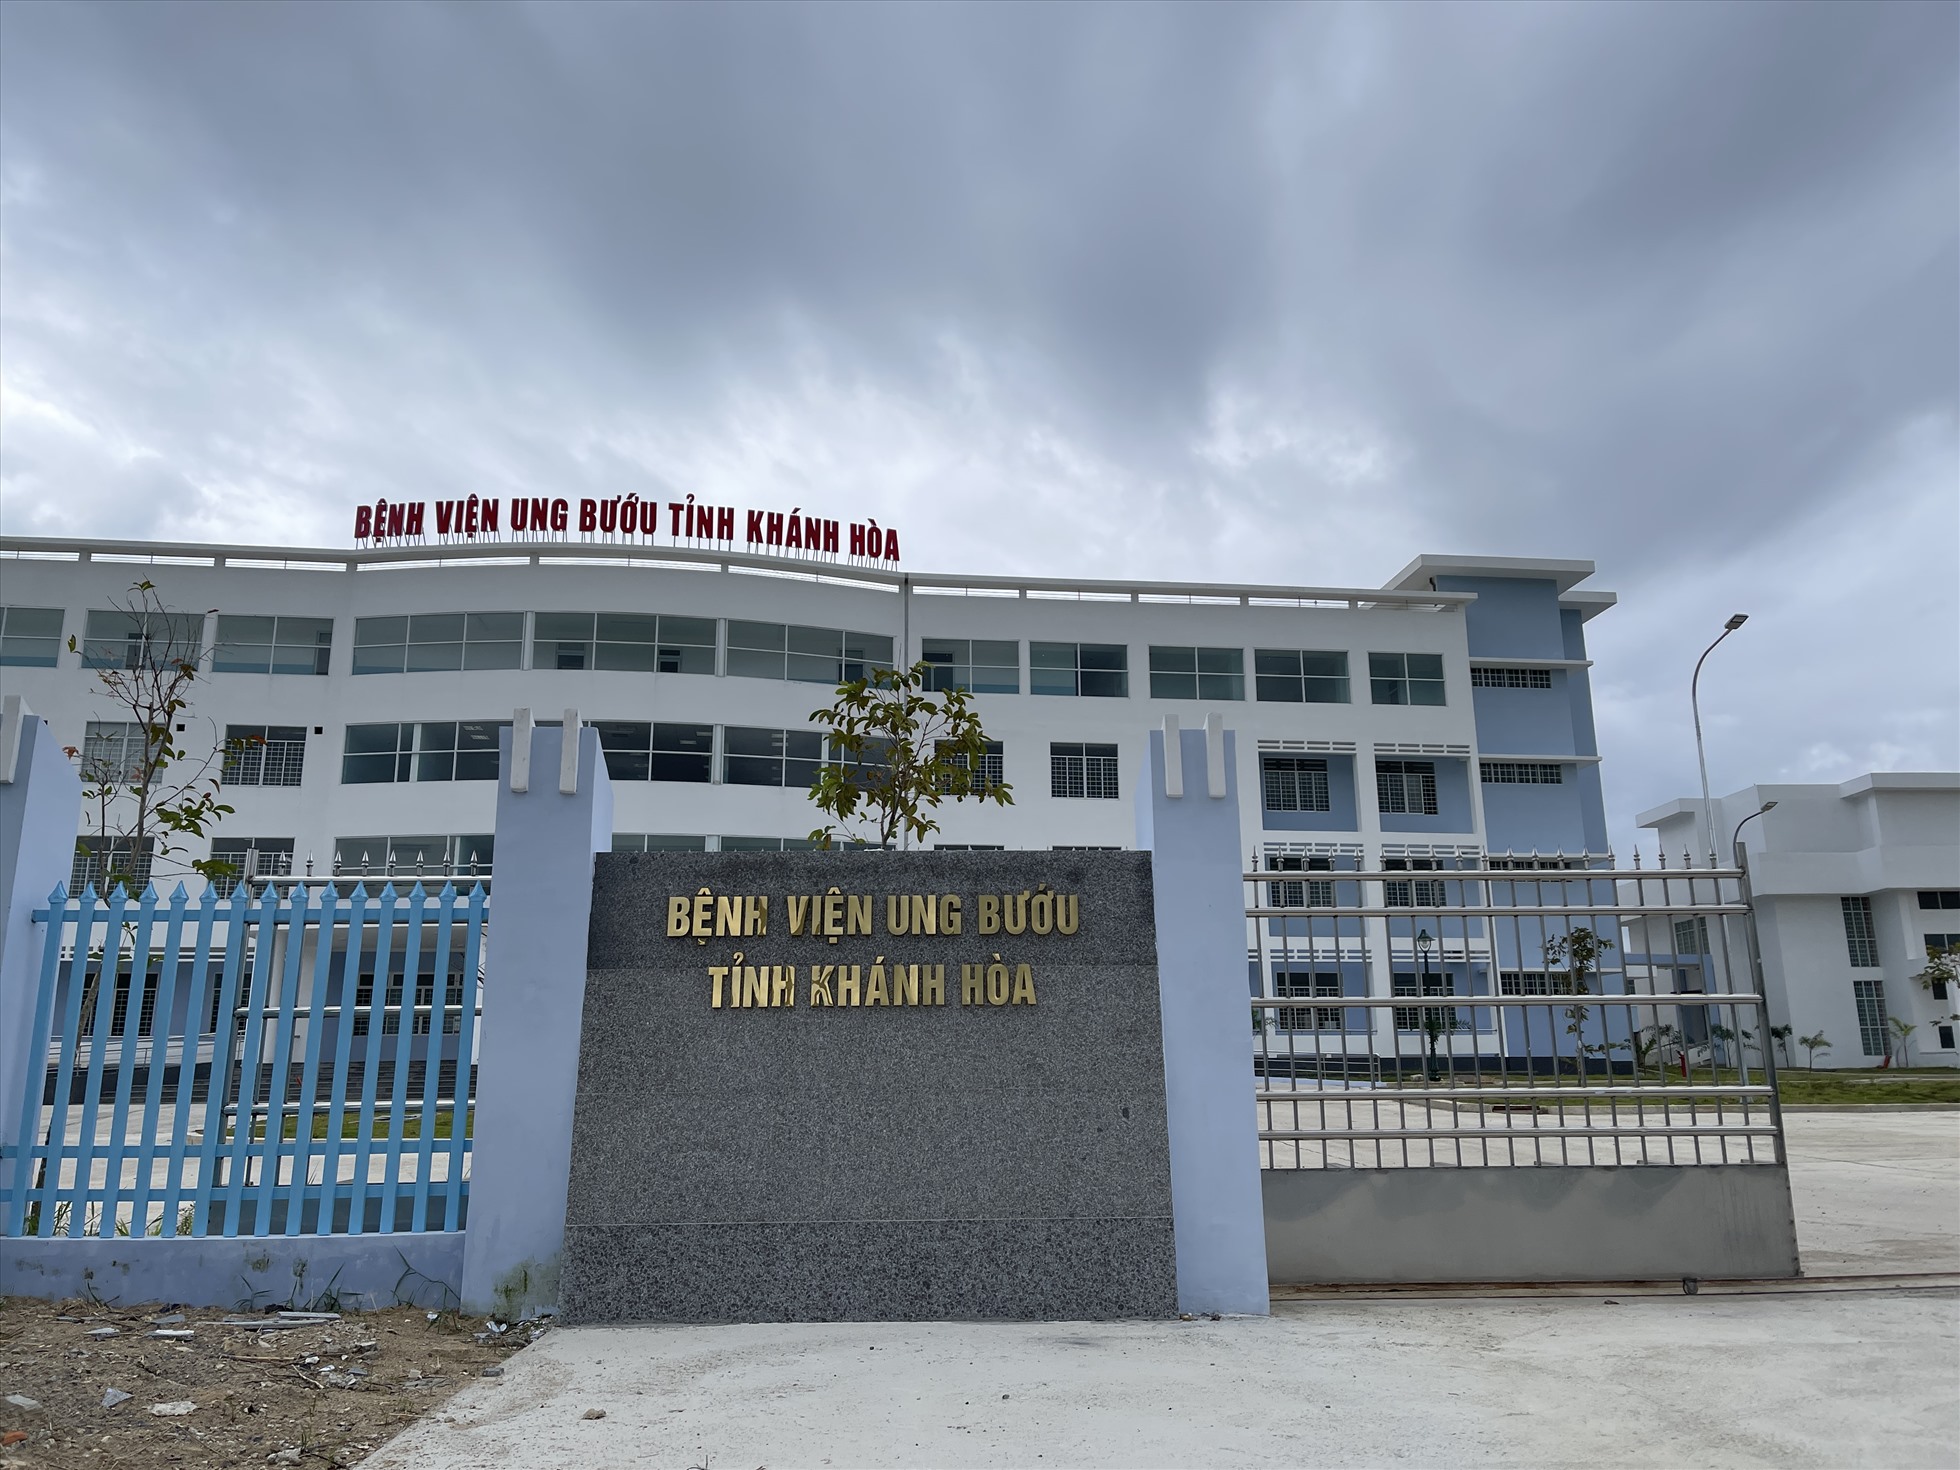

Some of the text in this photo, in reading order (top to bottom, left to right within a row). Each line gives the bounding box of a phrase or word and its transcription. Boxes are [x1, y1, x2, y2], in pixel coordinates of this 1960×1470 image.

[354, 492, 900, 561] BỆNH VIỆN UNG BƯỚU TỈNH KHÁNH HÒA
[667, 883, 1079, 945] BỆNH VIỆN UNG BƯỚU
[708, 951, 1037, 1008] TỈNH KHÁNH HÒA
